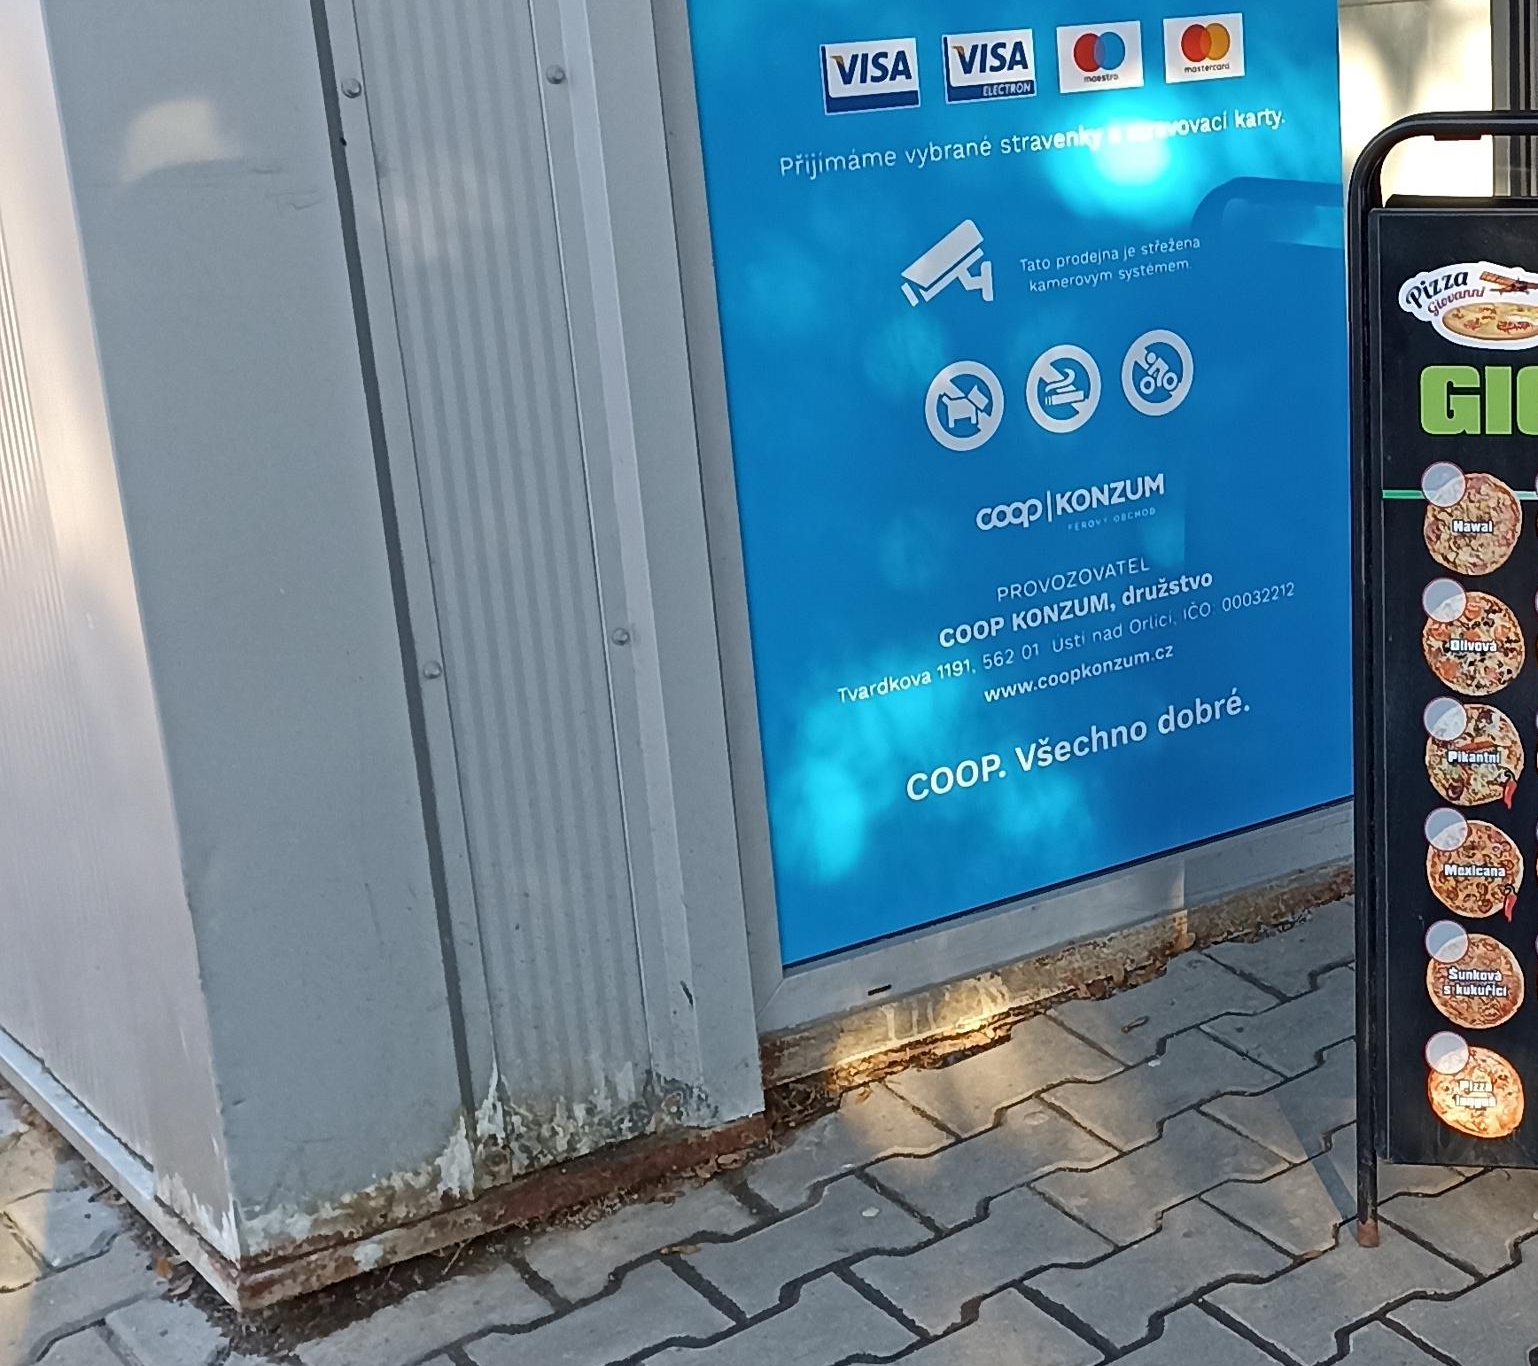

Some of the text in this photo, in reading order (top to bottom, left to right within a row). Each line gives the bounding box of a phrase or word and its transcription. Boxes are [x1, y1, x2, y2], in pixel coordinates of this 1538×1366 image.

[831, 50, 913, 85] VISA
[953, 41, 1029, 75] VISA
[1183, 62, 1231, 74] mastercard
[982, 81, 1032, 97] ELECTRON
[1083, 72, 1119, 83] maestro
[779, 146, 896, 181] Přijímáme
[906, 134, 992, 168] vybrané
[1000, 124, 1104, 154] stravenky
[1235, 108, 1285, 131] karty.
[1020, 237, 1201, 272] Tato prodejna je střežena
[1029, 269, 1113, 292] kamerovým
[1406, 272, 1469, 309] Pizza
[1428, 286, 1486, 317] Giovanni
[1113, 507, 1156, 524] OBCHOD
[997, 556, 1150, 601] PROVOZOVATEL
[939, 571, 1213, 648] COOP KONZUM, družstvo
[838, 667, 932, 704] Tvardkova
[937, 658, 976, 681] 1191,
[983, 648, 1015, 670] 562
[1022, 643, 1040, 661] 01
[1092, 624, 1123, 646] nad
[1222, 581, 1296, 612] 00032212
[1450, 638, 1498, 653] Olivová
[984, 643, 1174, 703] www.coopkonzum.cz
[906, 687, 1251, 802] COOP. Všechno dobré.
[1448, 751, 1500, 764] Pikantní
[1444, 863, 1506, 878] Mexicana
[1448, 967, 1502, 982] Šunková
[1443, 987, 1451, 996] s
[1458, 1080, 1493, 1093] Pizza
